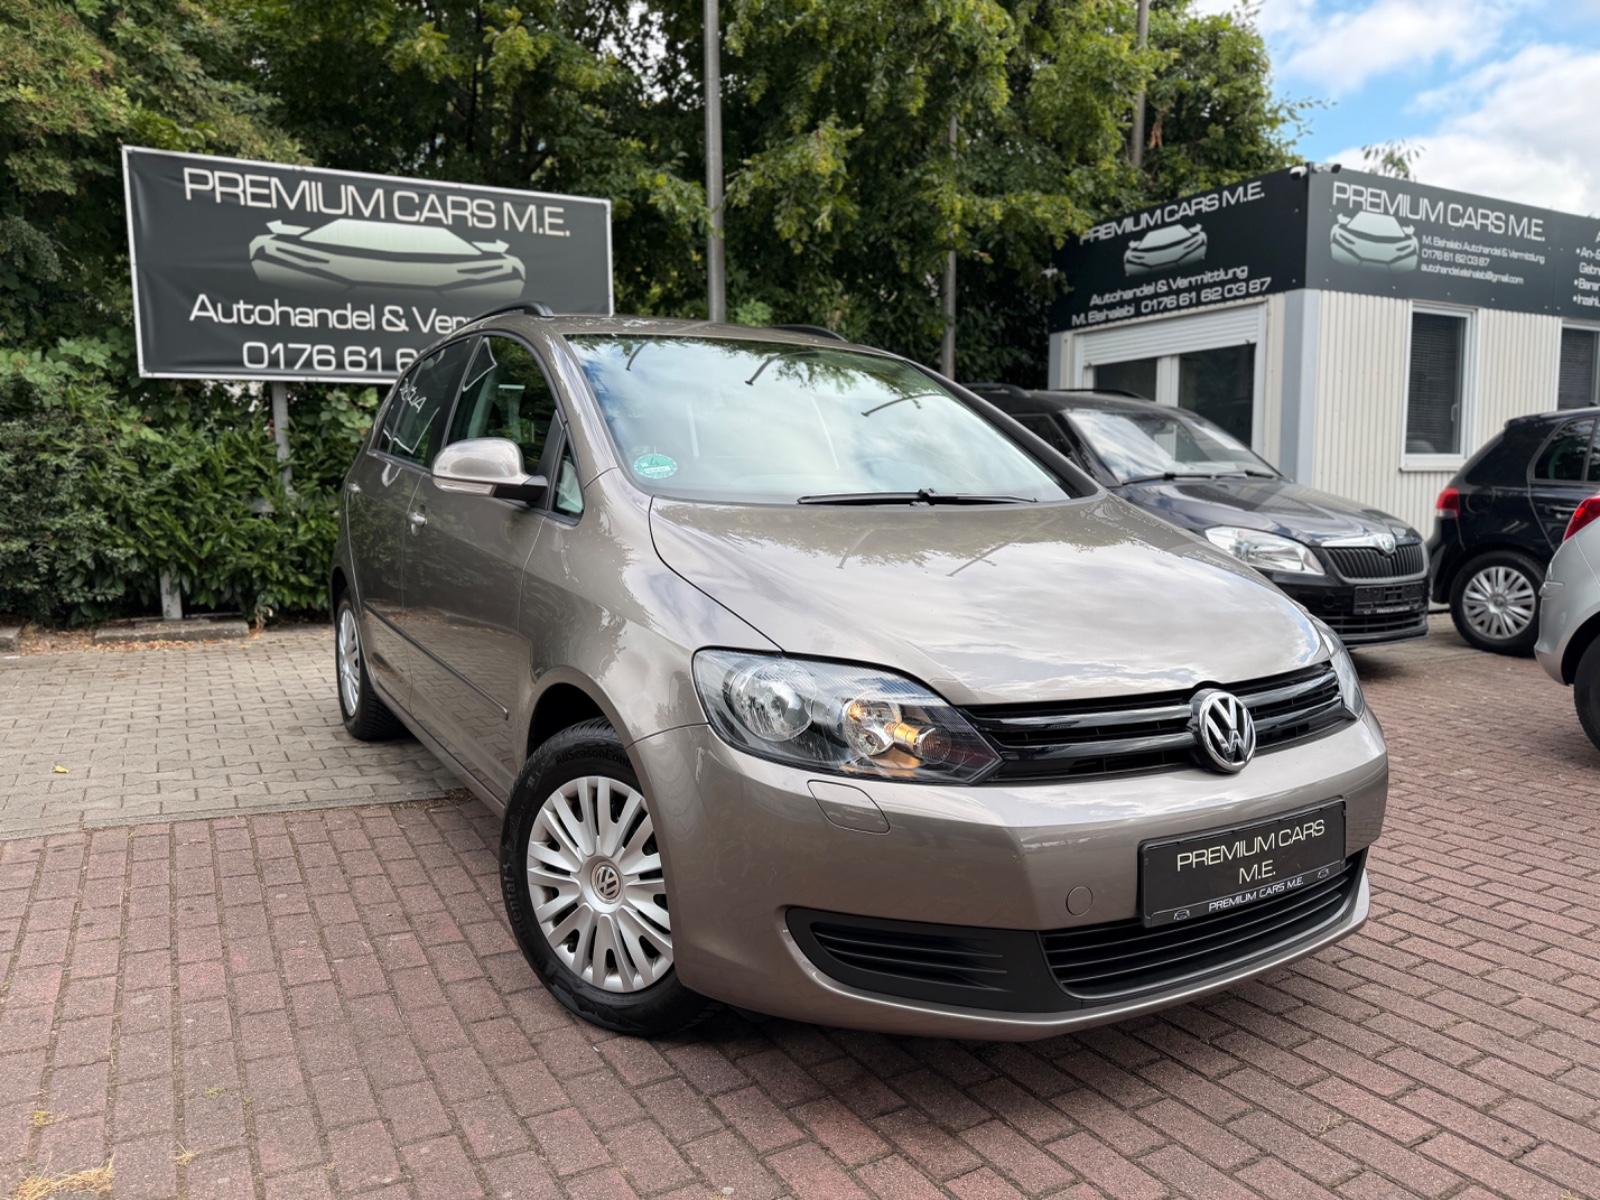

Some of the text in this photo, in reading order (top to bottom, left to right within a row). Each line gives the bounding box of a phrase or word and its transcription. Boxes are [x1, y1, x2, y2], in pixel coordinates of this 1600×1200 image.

[183, 167, 571, 237] PREMIUM CARS M.E.
[1164, 194, 1219, 222] CARS
[1222, 181, 1265, 208] M.E.
[1332, 181, 1545, 242] PREMIUM CARS M.E.
[1072, 313, 1086, 326] M.
[1141, 295, 1177, 314] 0176
[1179, 291, 1197, 307] 61
[1200, 287, 1222, 302] 62
[1224, 282, 1247, 298] 03
[1248, 277, 1272, 294] 87
[1089, 265, 1248, 307] Autohandel & Vermittlung
[189, 294, 470, 334] Autohandel & Ver
[243, 342, 336, 372] 0176
[344, 346, 382, 374] 61
[1177, 819, 1326, 872] PREMIUM CARS
[1238, 859, 1277, 884] M.E.
[1208, 876, 1304, 913] PREMIUM CARS M.E.
